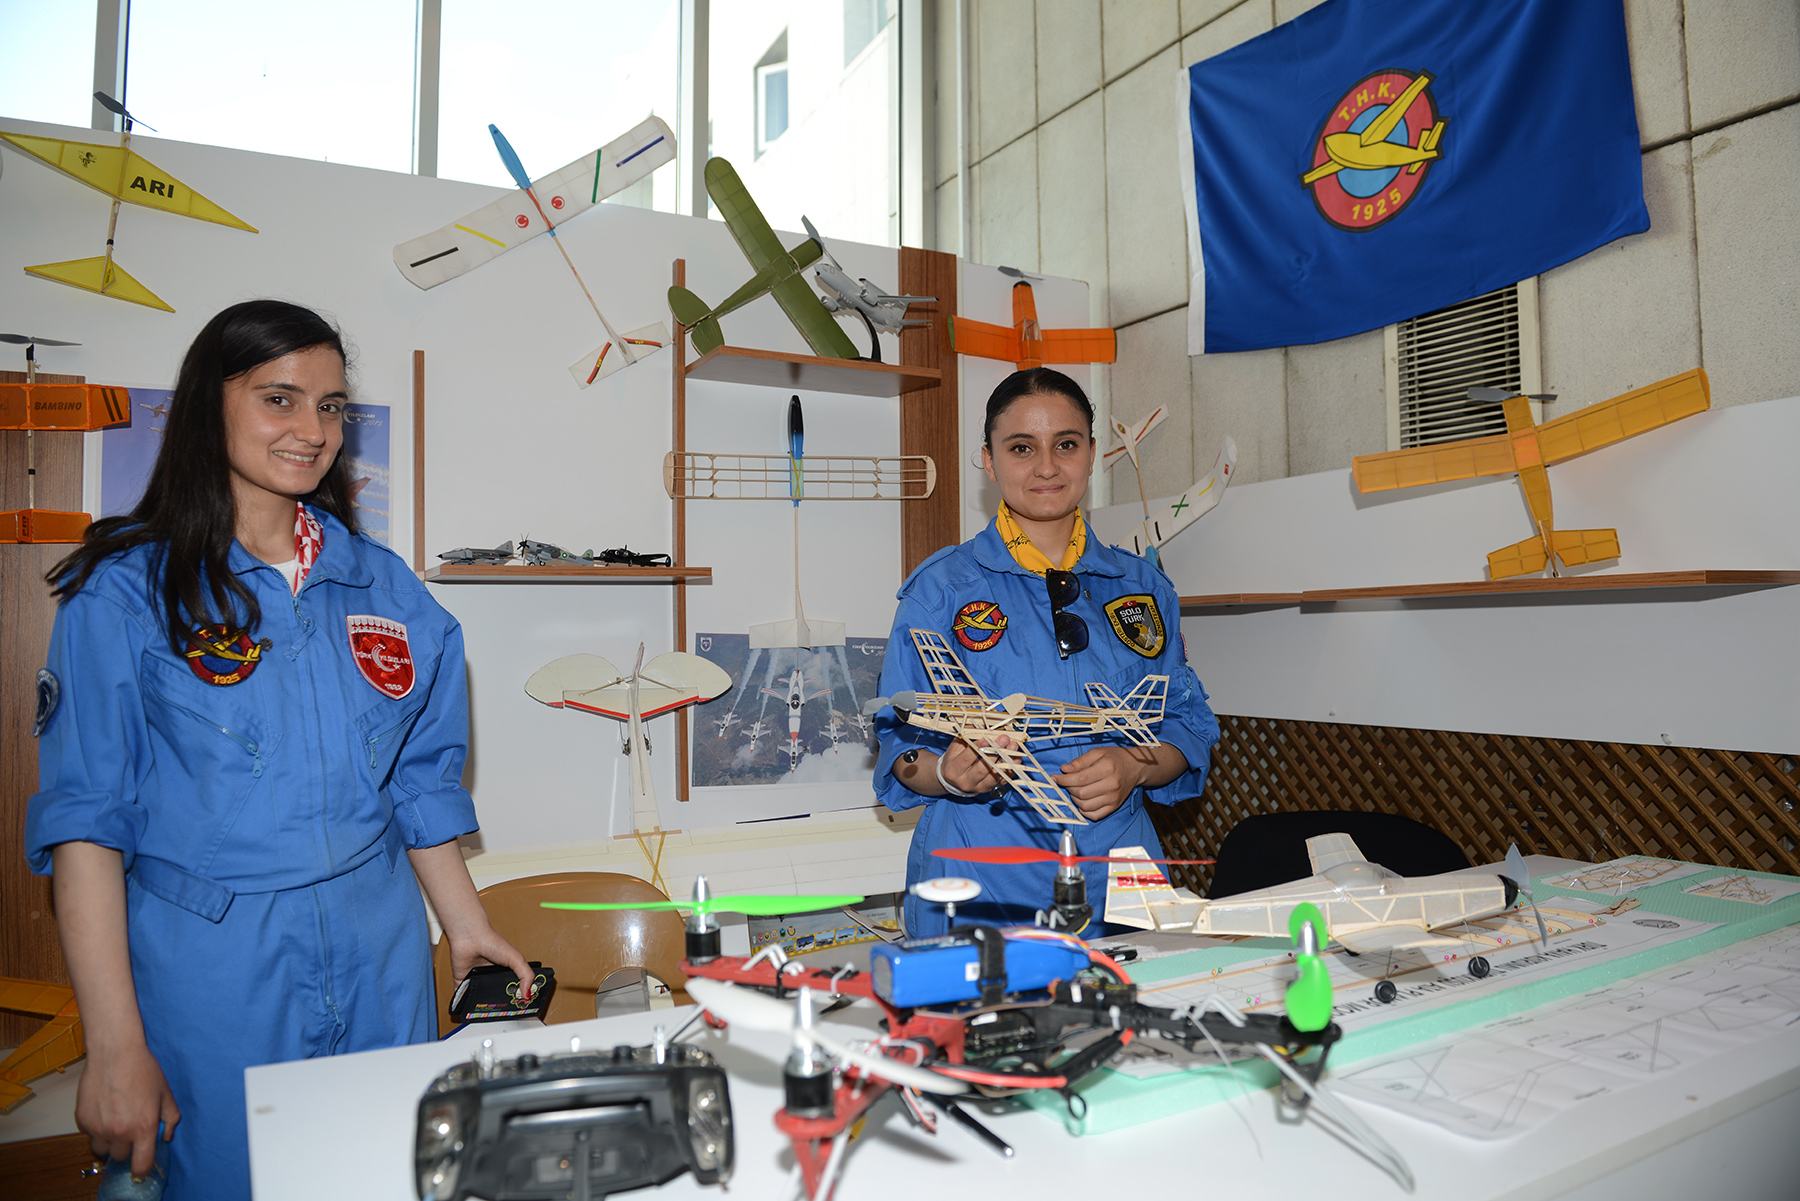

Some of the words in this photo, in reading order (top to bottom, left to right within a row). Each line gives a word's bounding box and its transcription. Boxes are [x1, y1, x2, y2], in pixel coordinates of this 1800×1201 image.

[1338, 82, 1396, 121] T.H.K.
[130, 176, 174, 199] ARI
[1352, 187, 1401, 220] 1925
[34, 402, 82, 411] BAMBINO
[1119, 606, 1142, 618] SOLO
[973, 639, 993, 650] 1925
[212, 672, 240, 685] 1925
